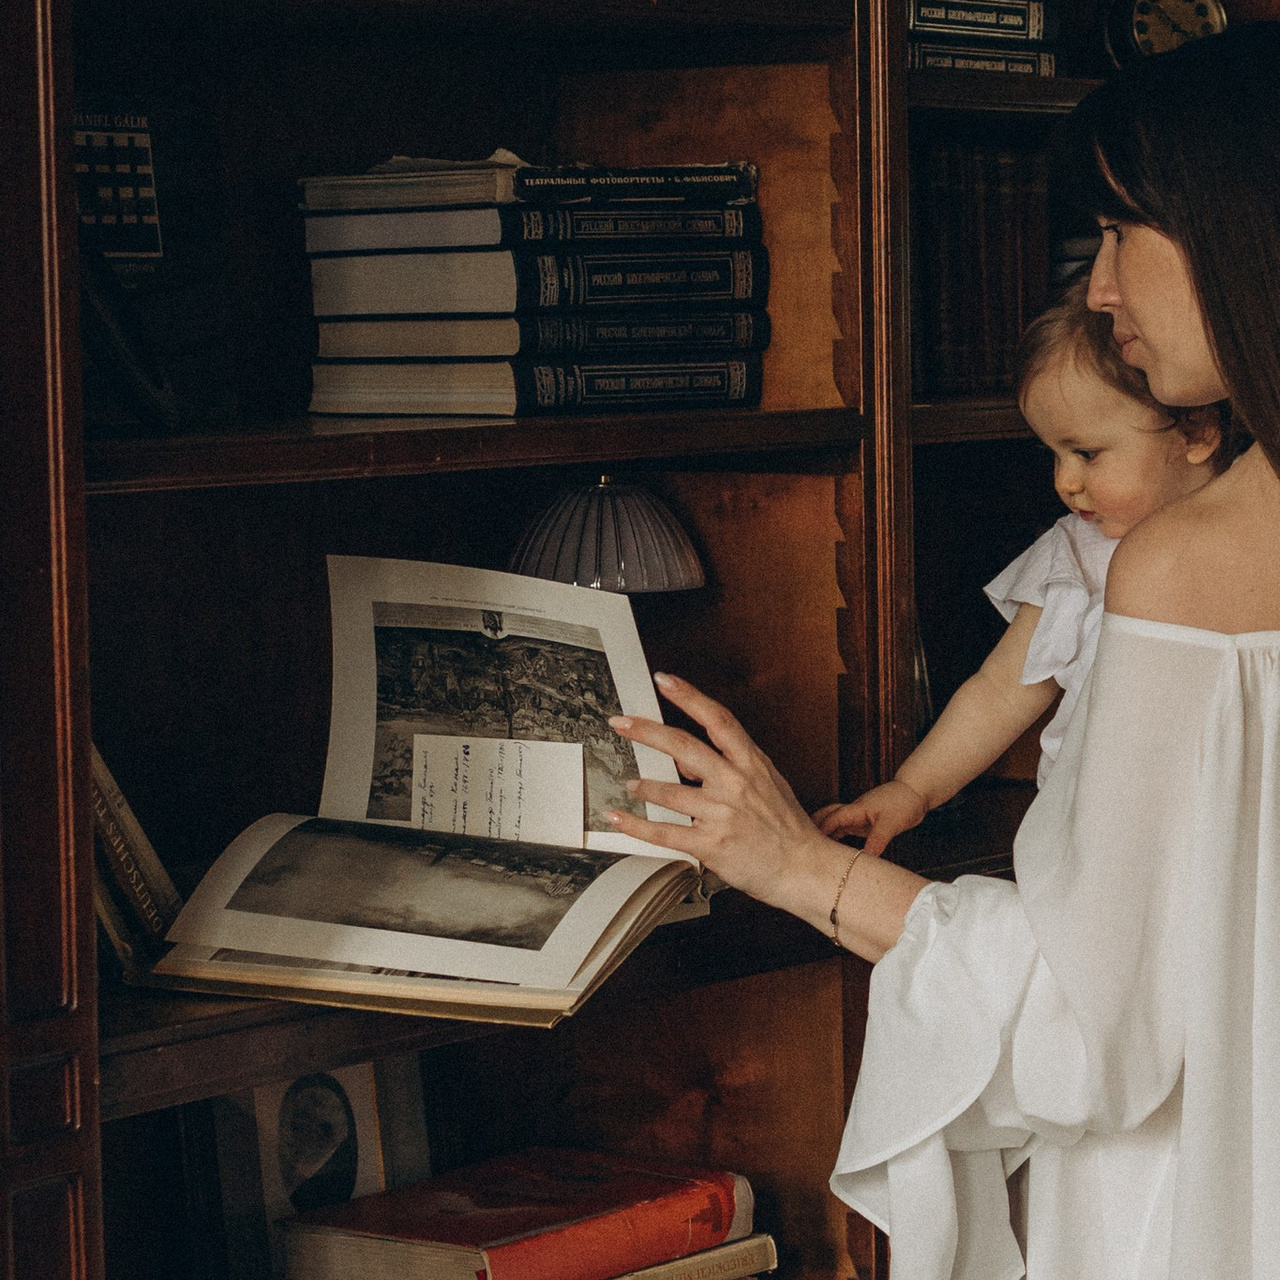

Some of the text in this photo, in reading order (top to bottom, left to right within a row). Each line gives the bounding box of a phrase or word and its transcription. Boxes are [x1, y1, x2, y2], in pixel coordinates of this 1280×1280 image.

[524, 177, 587, 187] ТЕАТРАЛЬНЫЕ
[590, 176, 665, 186] ФОТОПОРТРЕТЫ
[106, 821, 162, 933] DEUTSCHES
